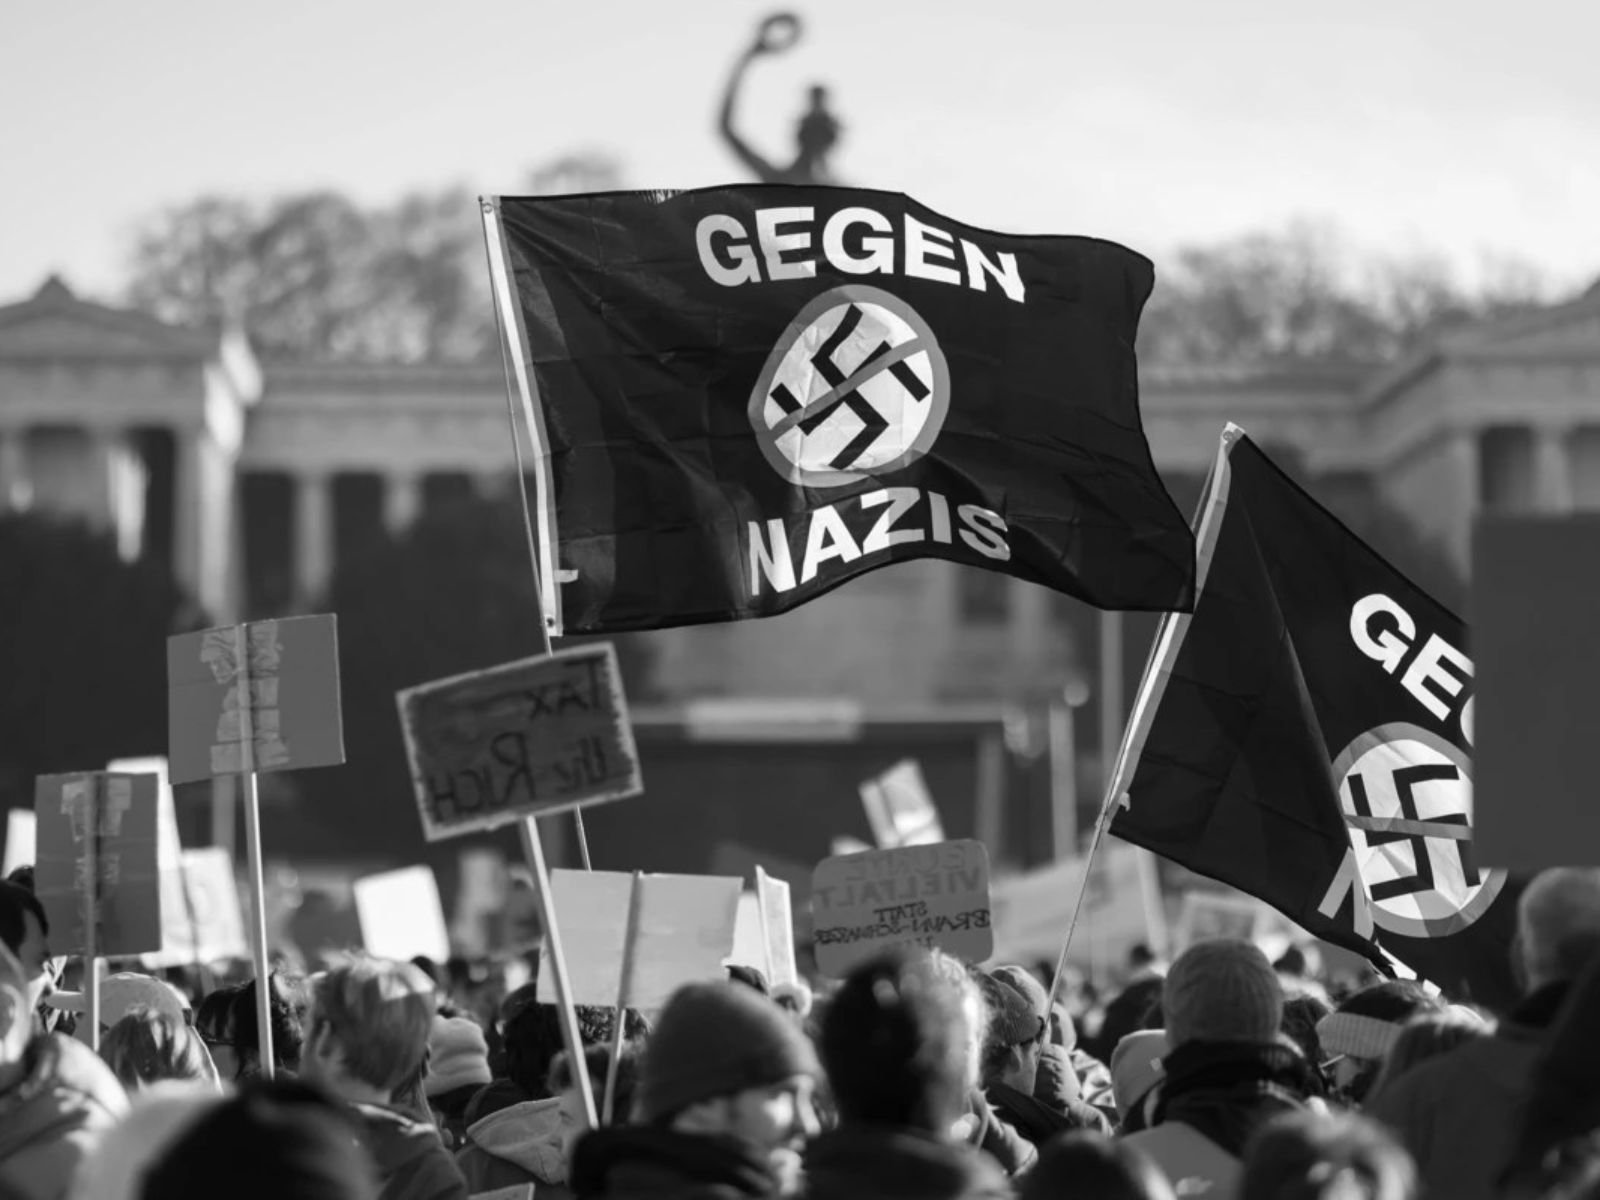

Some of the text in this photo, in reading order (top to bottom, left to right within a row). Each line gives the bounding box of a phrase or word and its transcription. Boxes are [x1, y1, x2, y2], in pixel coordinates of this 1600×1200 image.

[696, 206, 1025, 303] GEGEN
[747, 487, 1011, 596] NAZIS
[1350, 593, 1475, 747] GE
